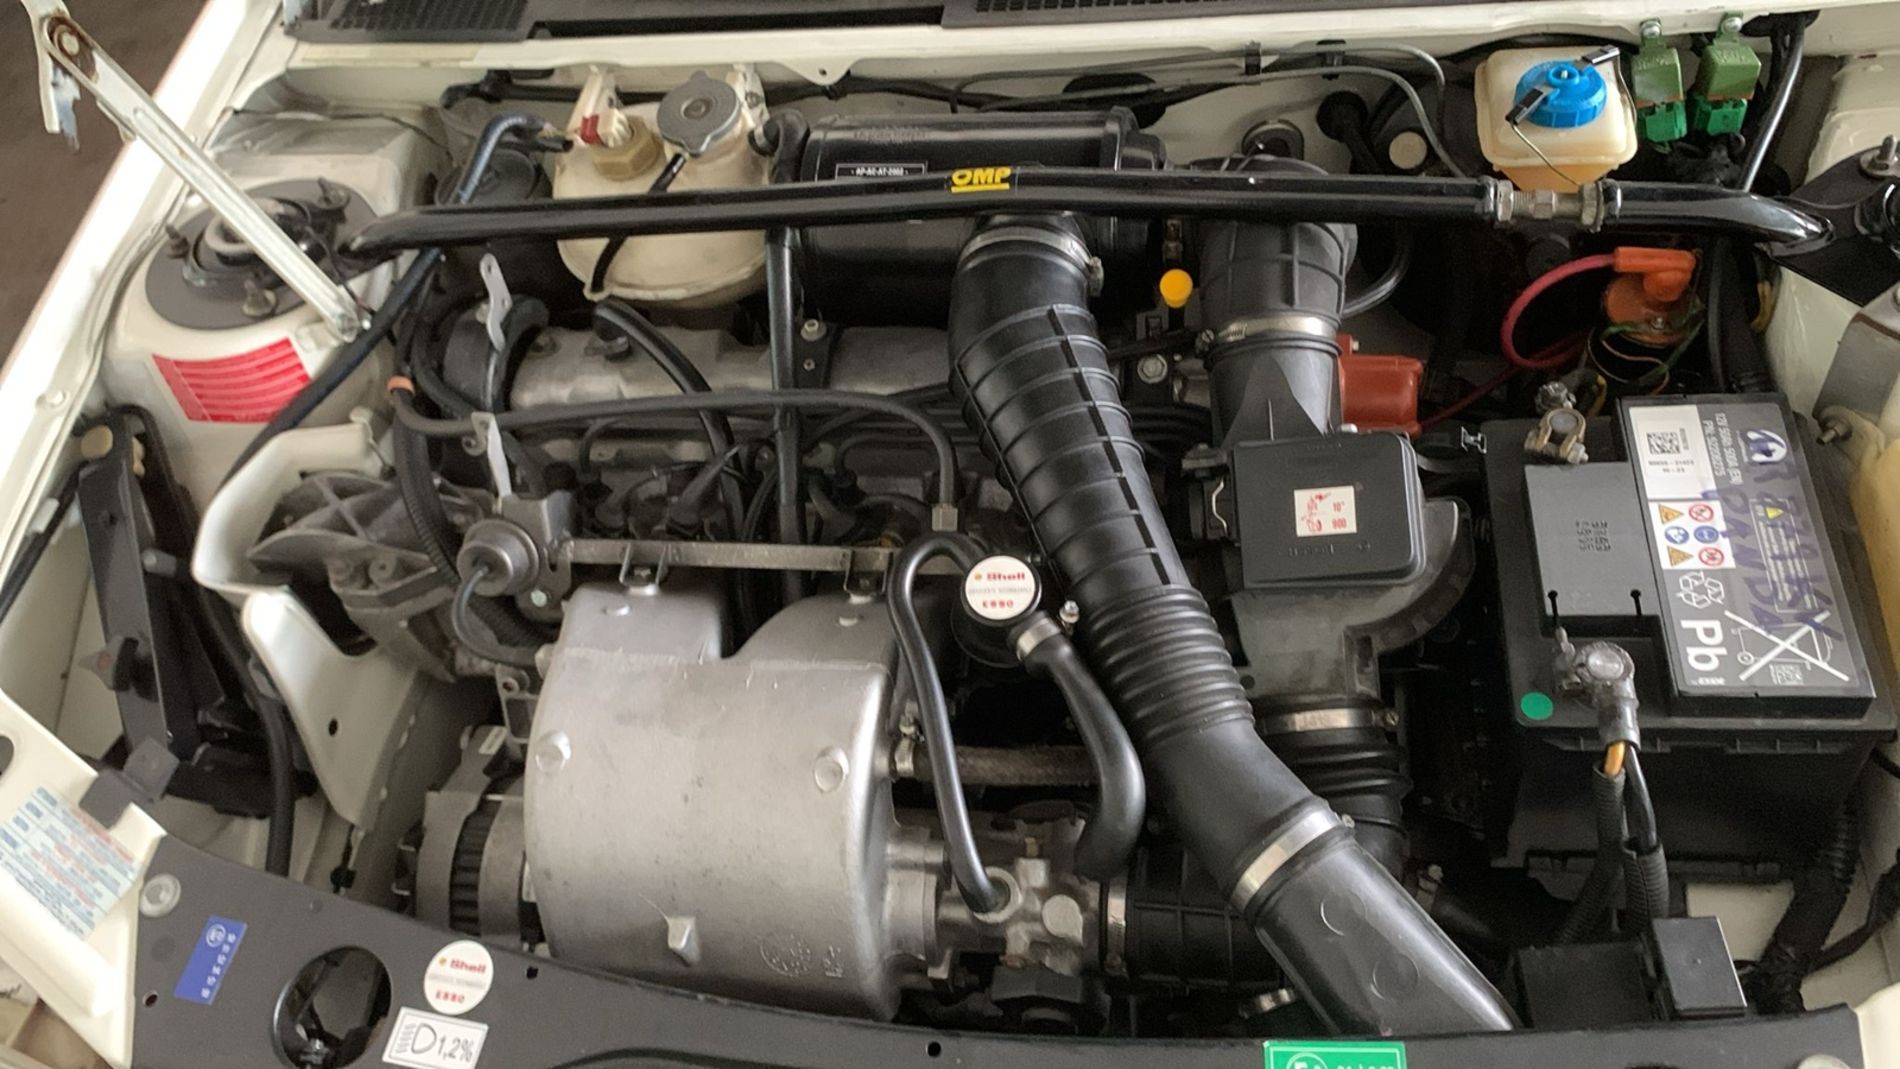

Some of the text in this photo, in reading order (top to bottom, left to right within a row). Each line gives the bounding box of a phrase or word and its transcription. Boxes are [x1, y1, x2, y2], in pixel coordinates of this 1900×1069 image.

[952, 166, 1012, 186] OMP
[987, 572, 1025, 581] Shell
[1680, 620, 1728, 671] Pb
[450, 959, 487, 973] Shell
[438, 1035, 474, 1062] 1,2%
